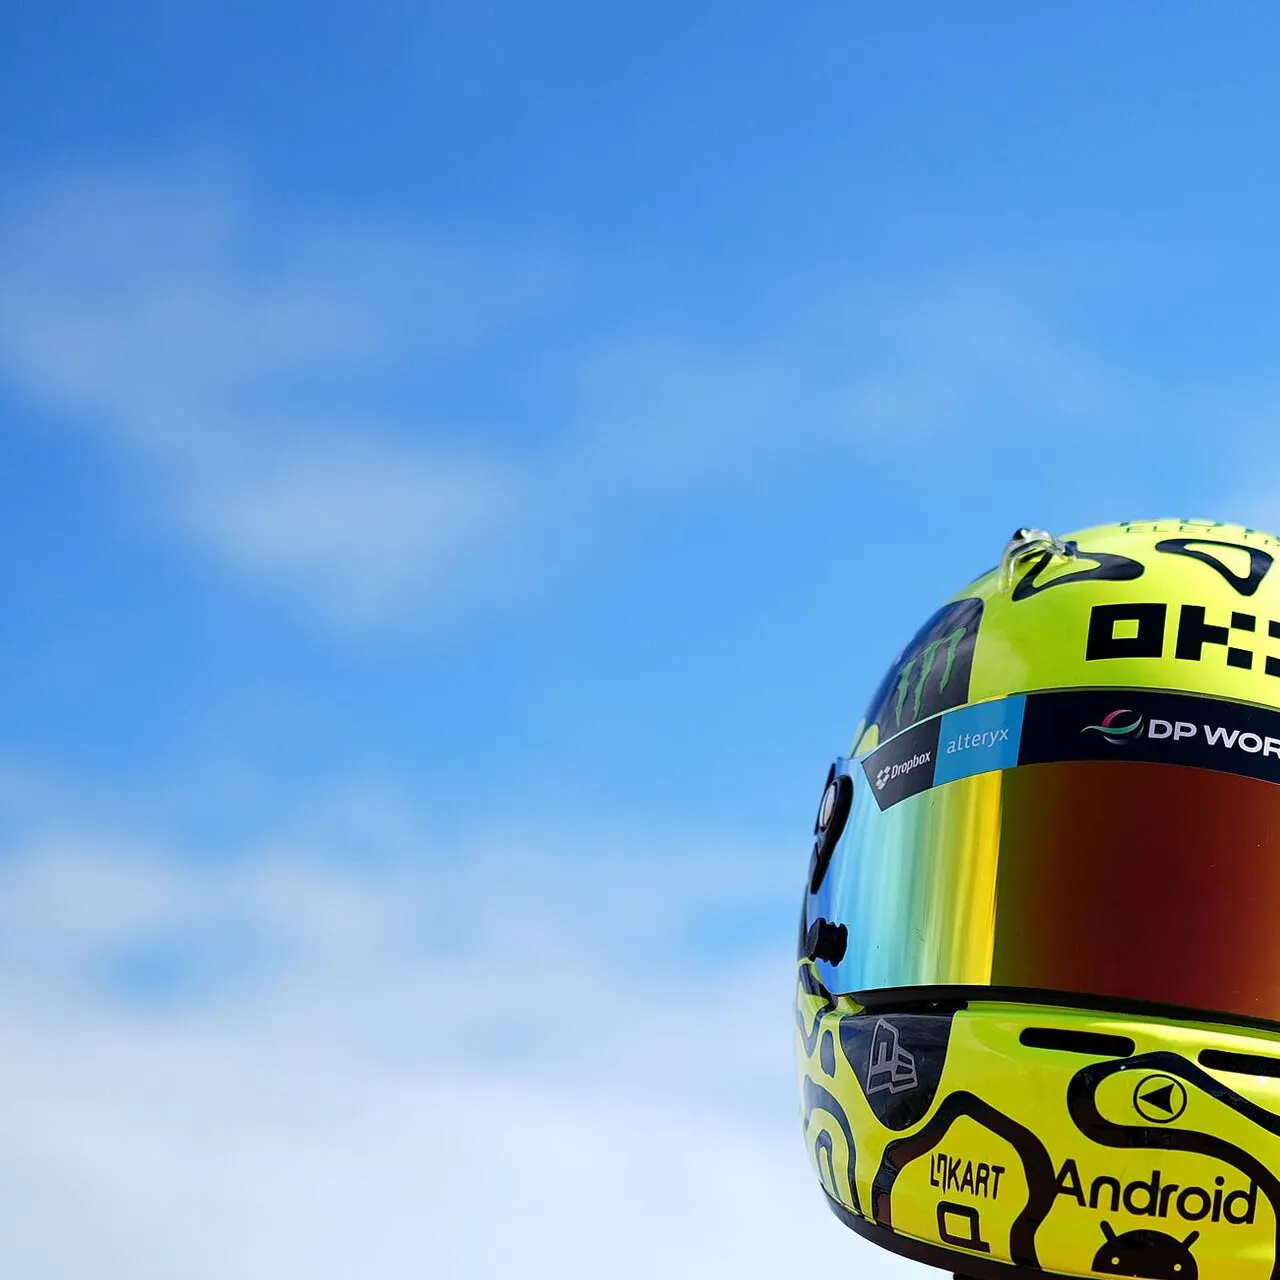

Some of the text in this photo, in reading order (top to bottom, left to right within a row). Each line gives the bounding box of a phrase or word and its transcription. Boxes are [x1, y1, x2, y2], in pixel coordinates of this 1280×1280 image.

[946, 728, 1009, 754] alteryx
[1148, 719, 1198, 741] DP
[890, 751, 932, 779] Dropbox
[1054, 1158, 1258, 1225] Android
